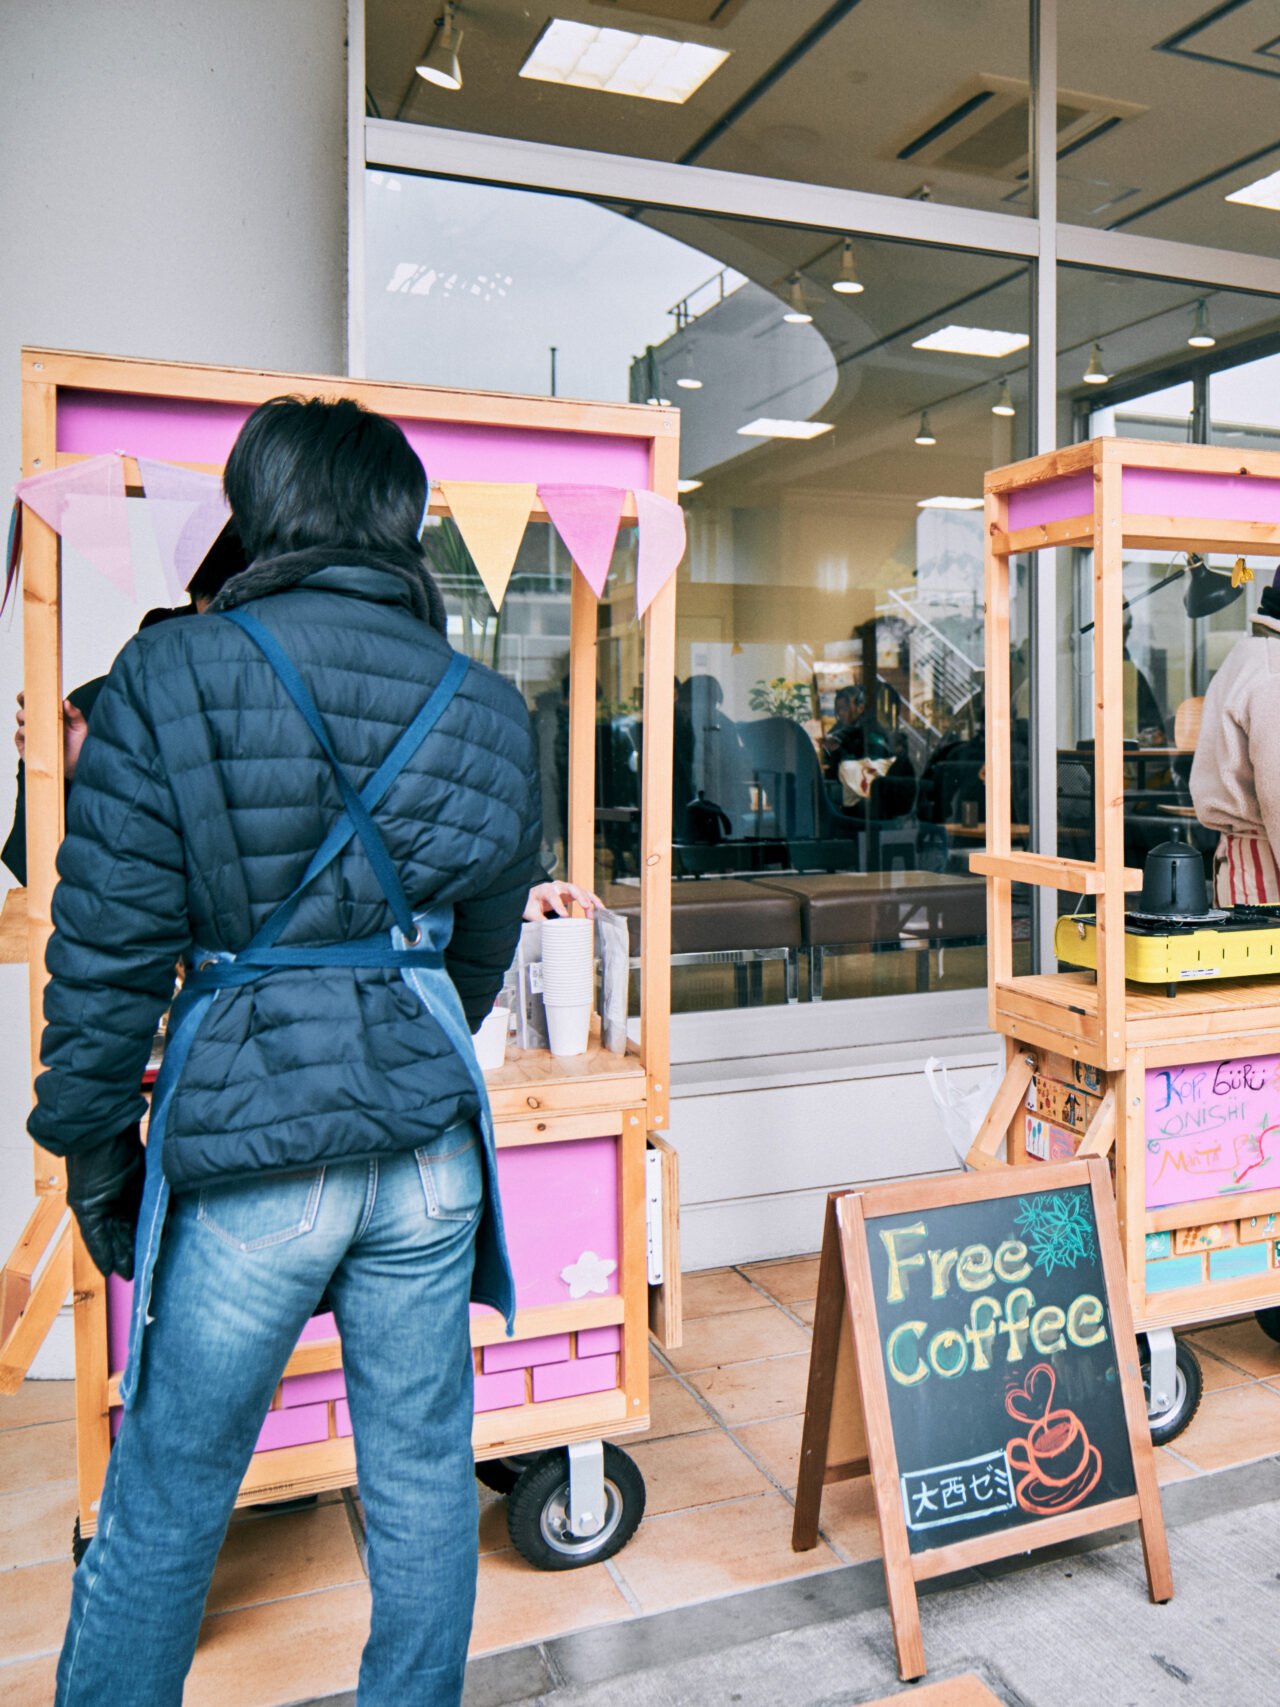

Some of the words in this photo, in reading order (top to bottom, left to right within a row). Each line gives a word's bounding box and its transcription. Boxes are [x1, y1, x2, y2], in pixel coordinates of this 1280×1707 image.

[879, 1221, 1034, 1304] Free
[886, 1287, 1108, 1387] Coffee
[911, 1464, 1009, 1518] 大西ゼミ
